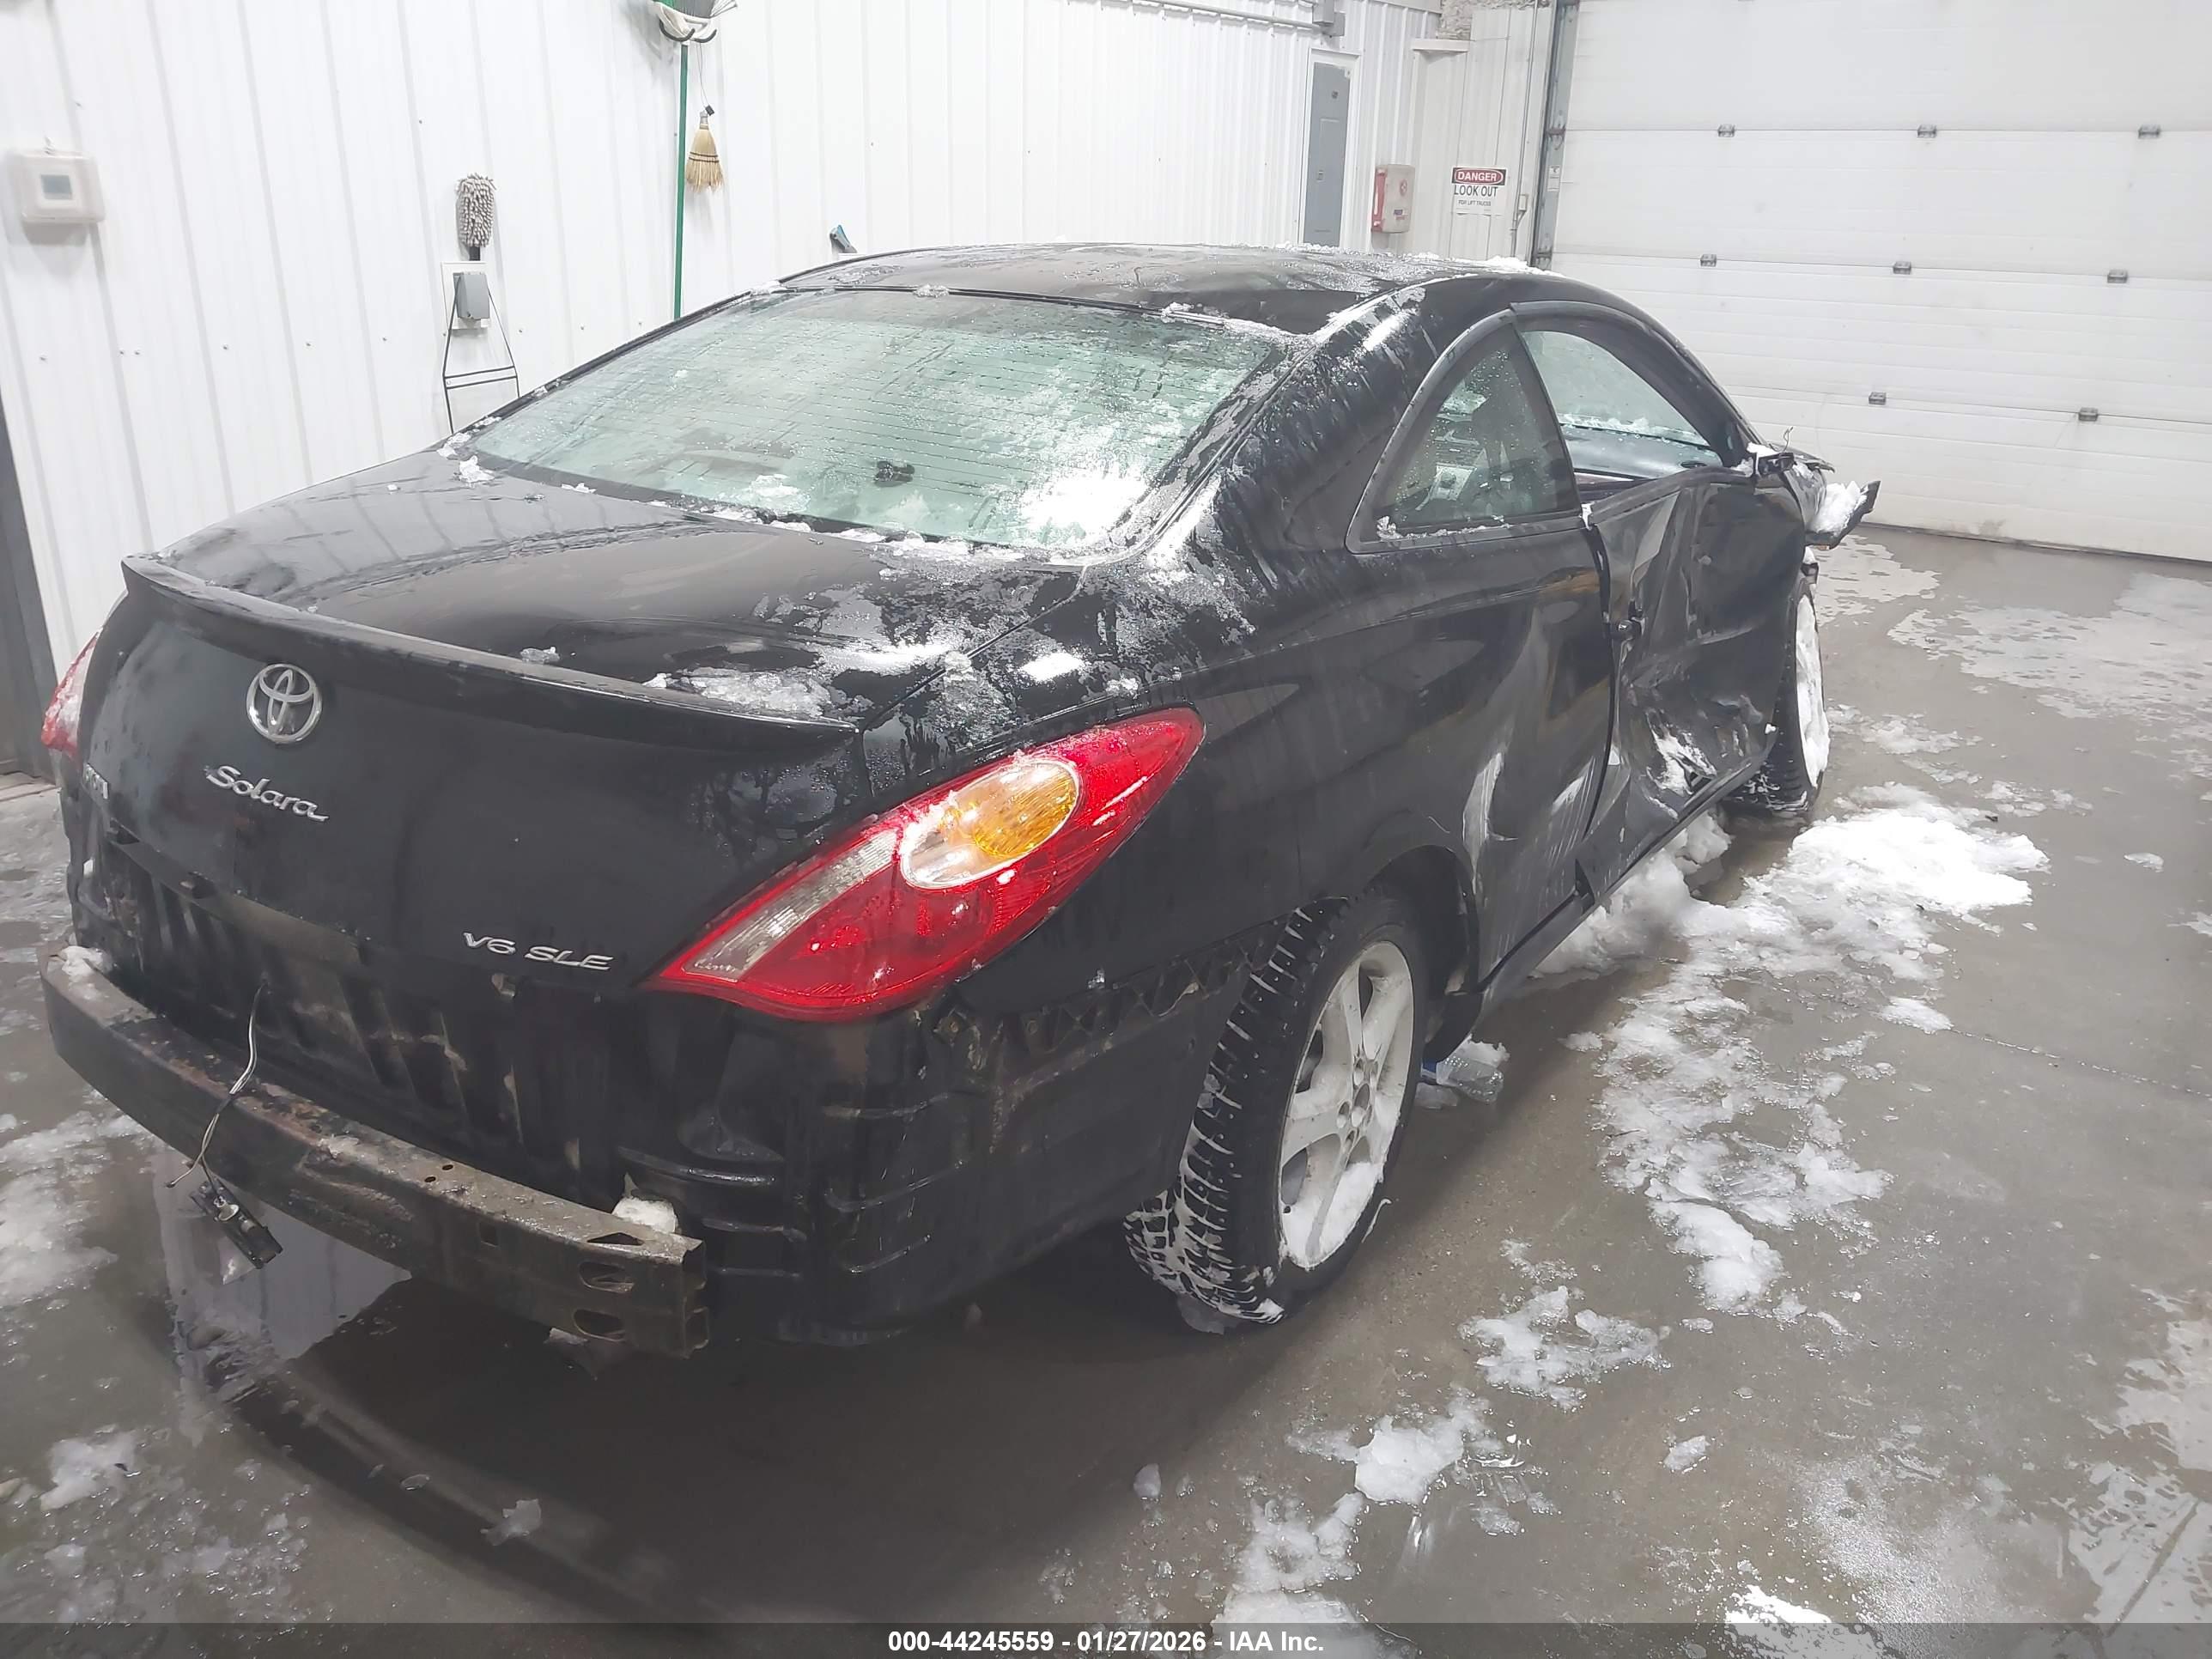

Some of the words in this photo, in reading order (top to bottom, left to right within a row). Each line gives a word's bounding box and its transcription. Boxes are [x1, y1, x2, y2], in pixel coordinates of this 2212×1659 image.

[1457, 171, 1497, 181] DANGER
[1454, 185, 1479, 196] LOOK
[1481, 186, 1498, 197] OUT
[204, 765, 330, 822] Solara
[463, 932, 516, 956] V6
[524, 945, 614, 971] SLE
